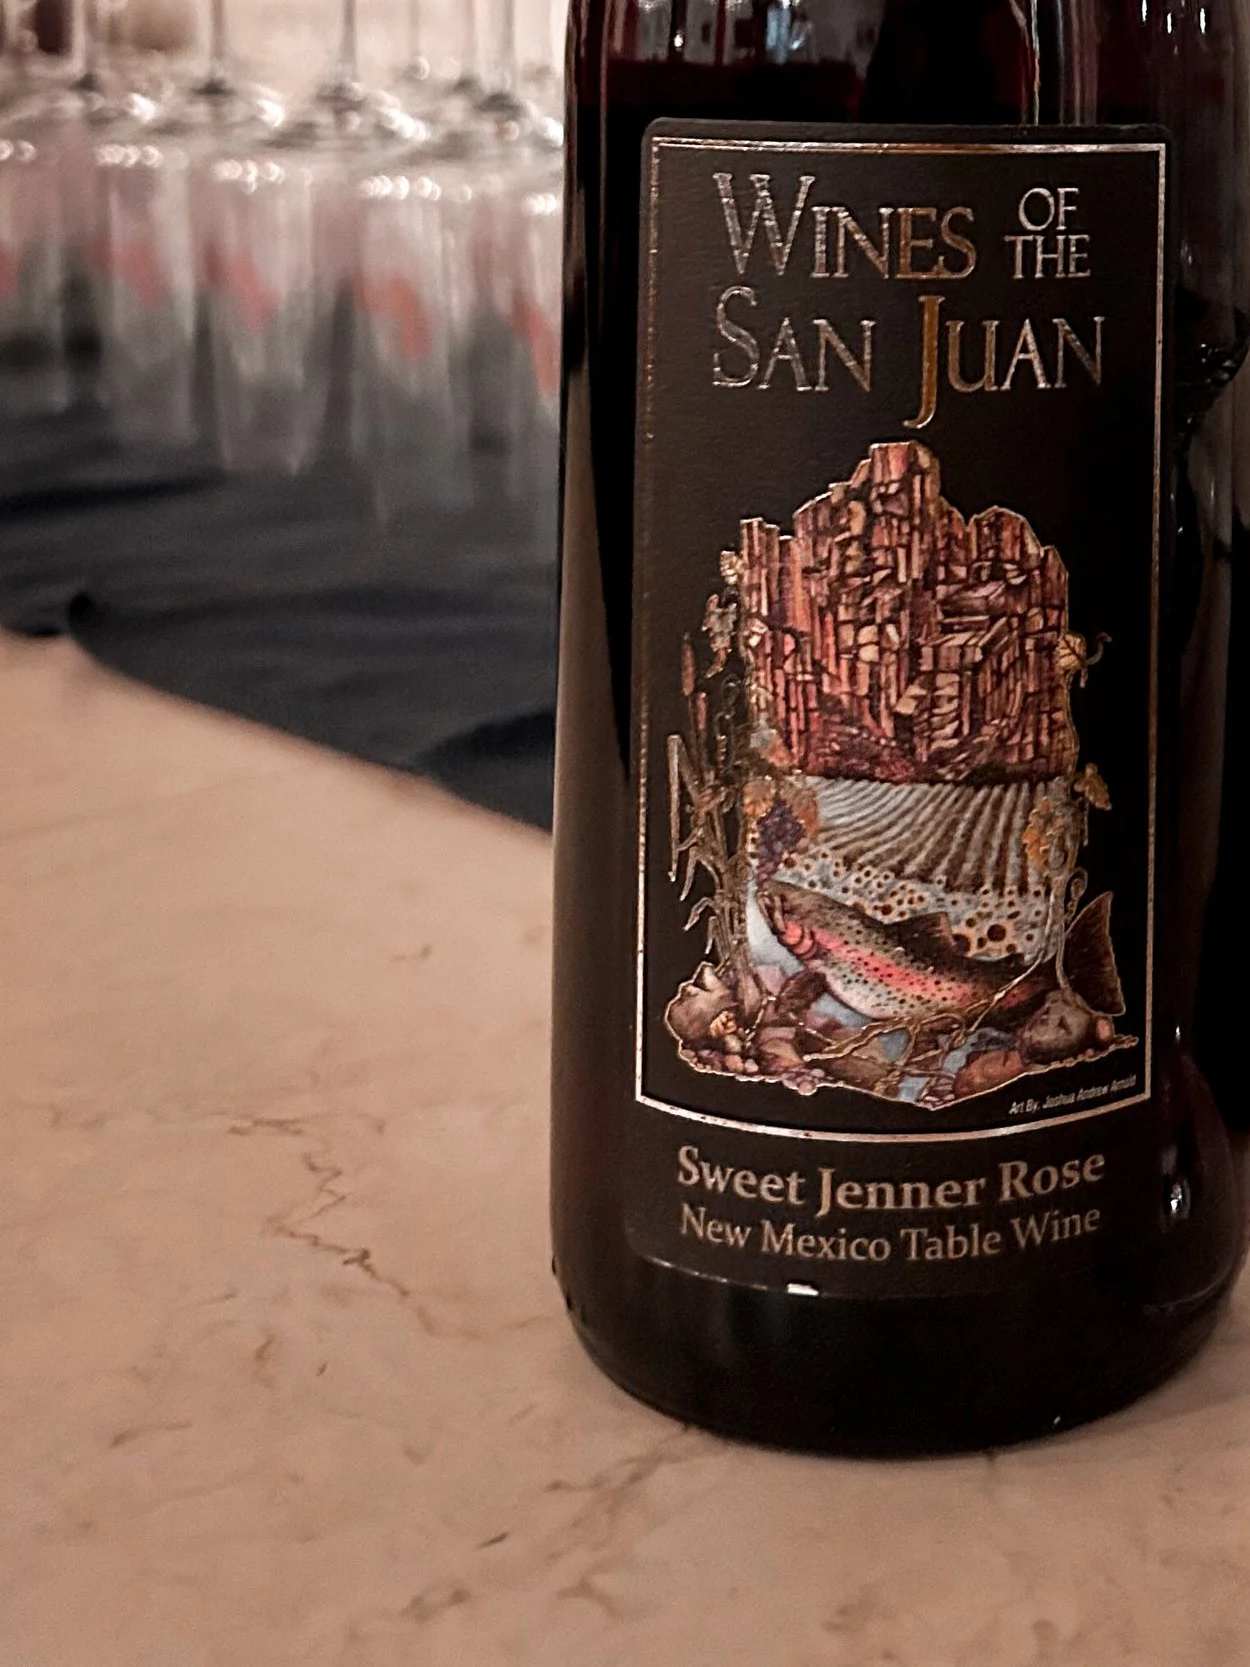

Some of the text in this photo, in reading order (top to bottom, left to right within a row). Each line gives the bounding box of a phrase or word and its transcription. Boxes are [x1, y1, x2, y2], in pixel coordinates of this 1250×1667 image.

[712, 172, 1092, 280] WINES OF THE
[712, 286, 1106, 429] SAN JUAN
[1009, 1101, 1024, 1115] Art
[1043, 1092, 1076, 1109] Joshua
[1077, 1085, 1110, 1101] Andrew
[677, 1145, 1106, 1218] Sweet Jenner Rose
[681, 1203, 1101, 1262] New Mexico Table Wine
